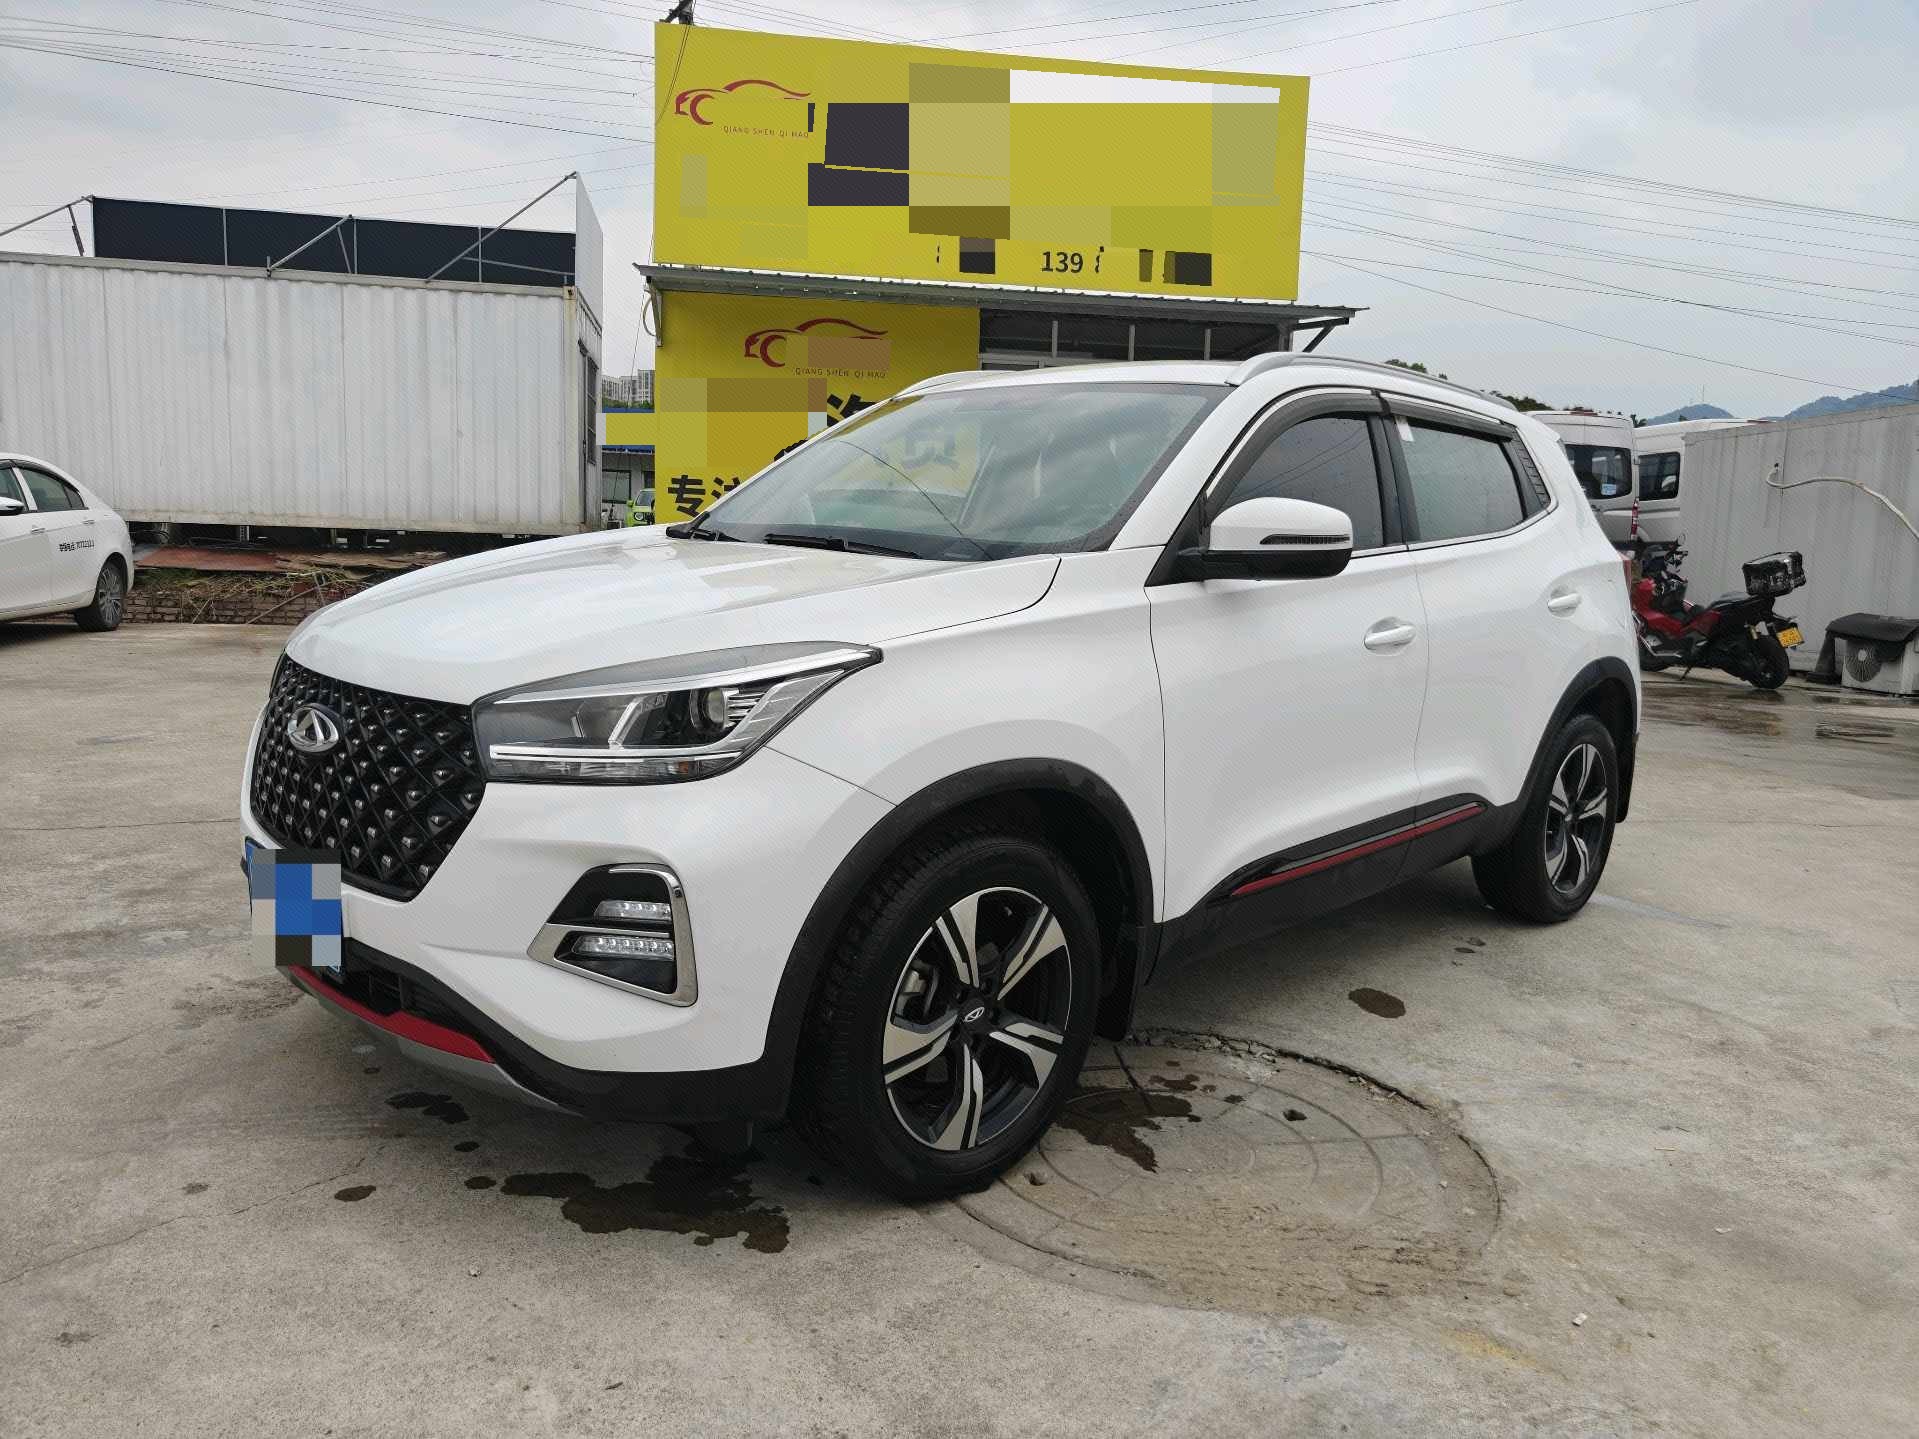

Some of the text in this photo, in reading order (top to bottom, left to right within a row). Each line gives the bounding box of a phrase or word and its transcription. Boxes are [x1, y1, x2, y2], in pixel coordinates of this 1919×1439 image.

[723, 125, 749, 134] QIANG
[779, 129, 788, 138] QI
[1042, 251, 1083, 273] 139
[795, 367, 823, 376] QIANG
[854, 369, 864, 379] QI
